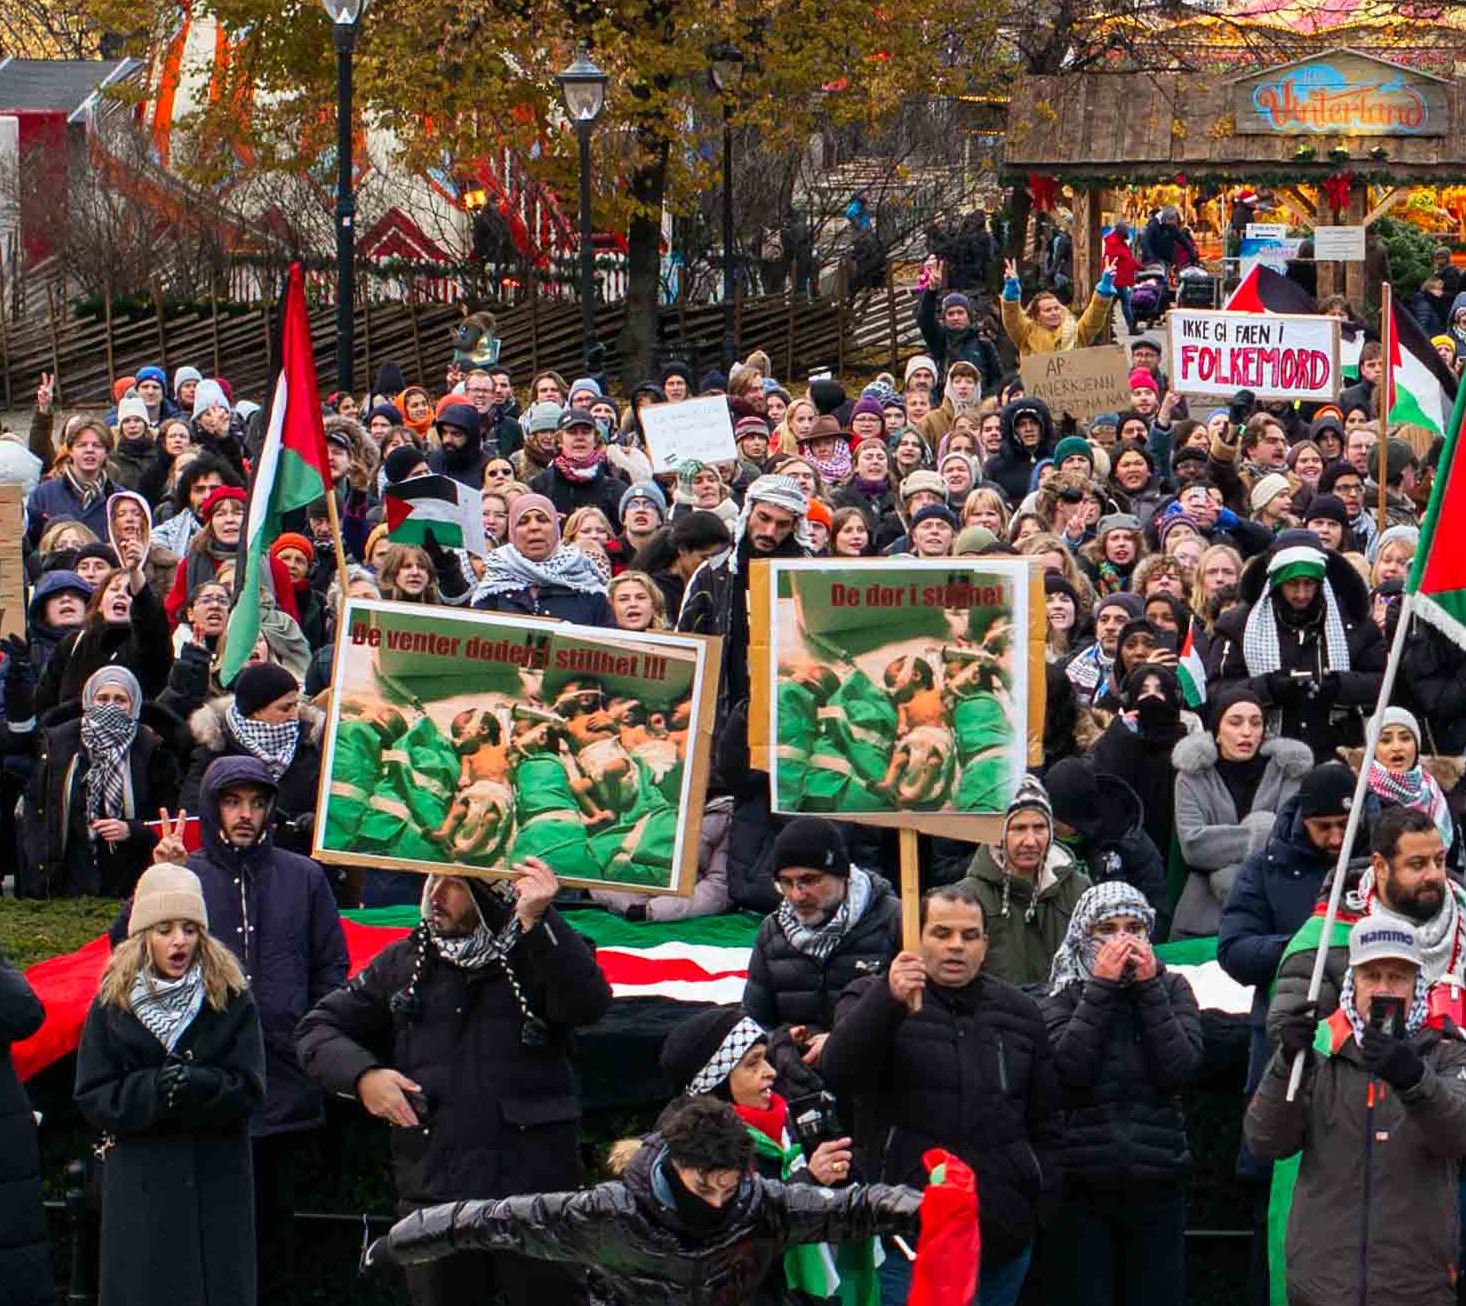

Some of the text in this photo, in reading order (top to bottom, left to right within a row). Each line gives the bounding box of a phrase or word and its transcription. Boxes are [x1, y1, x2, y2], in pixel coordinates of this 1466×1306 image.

[1258, 80, 1422, 128] Vinterland
[1183, 320, 1210, 340] IKKE
[1213, 321, 1228, 343] GI
[1236, 324, 1271, 345] FAEN
[1181, 345, 1331, 391] FOLKEMORD
[830, 582, 860, 607] De
[865, 582, 907, 607] dør
[351, 621, 381, 650] De
[385, 627, 459, 658] venter
[555, 645, 629, 678] stillhet
[641, 654, 668, 683] !!!
